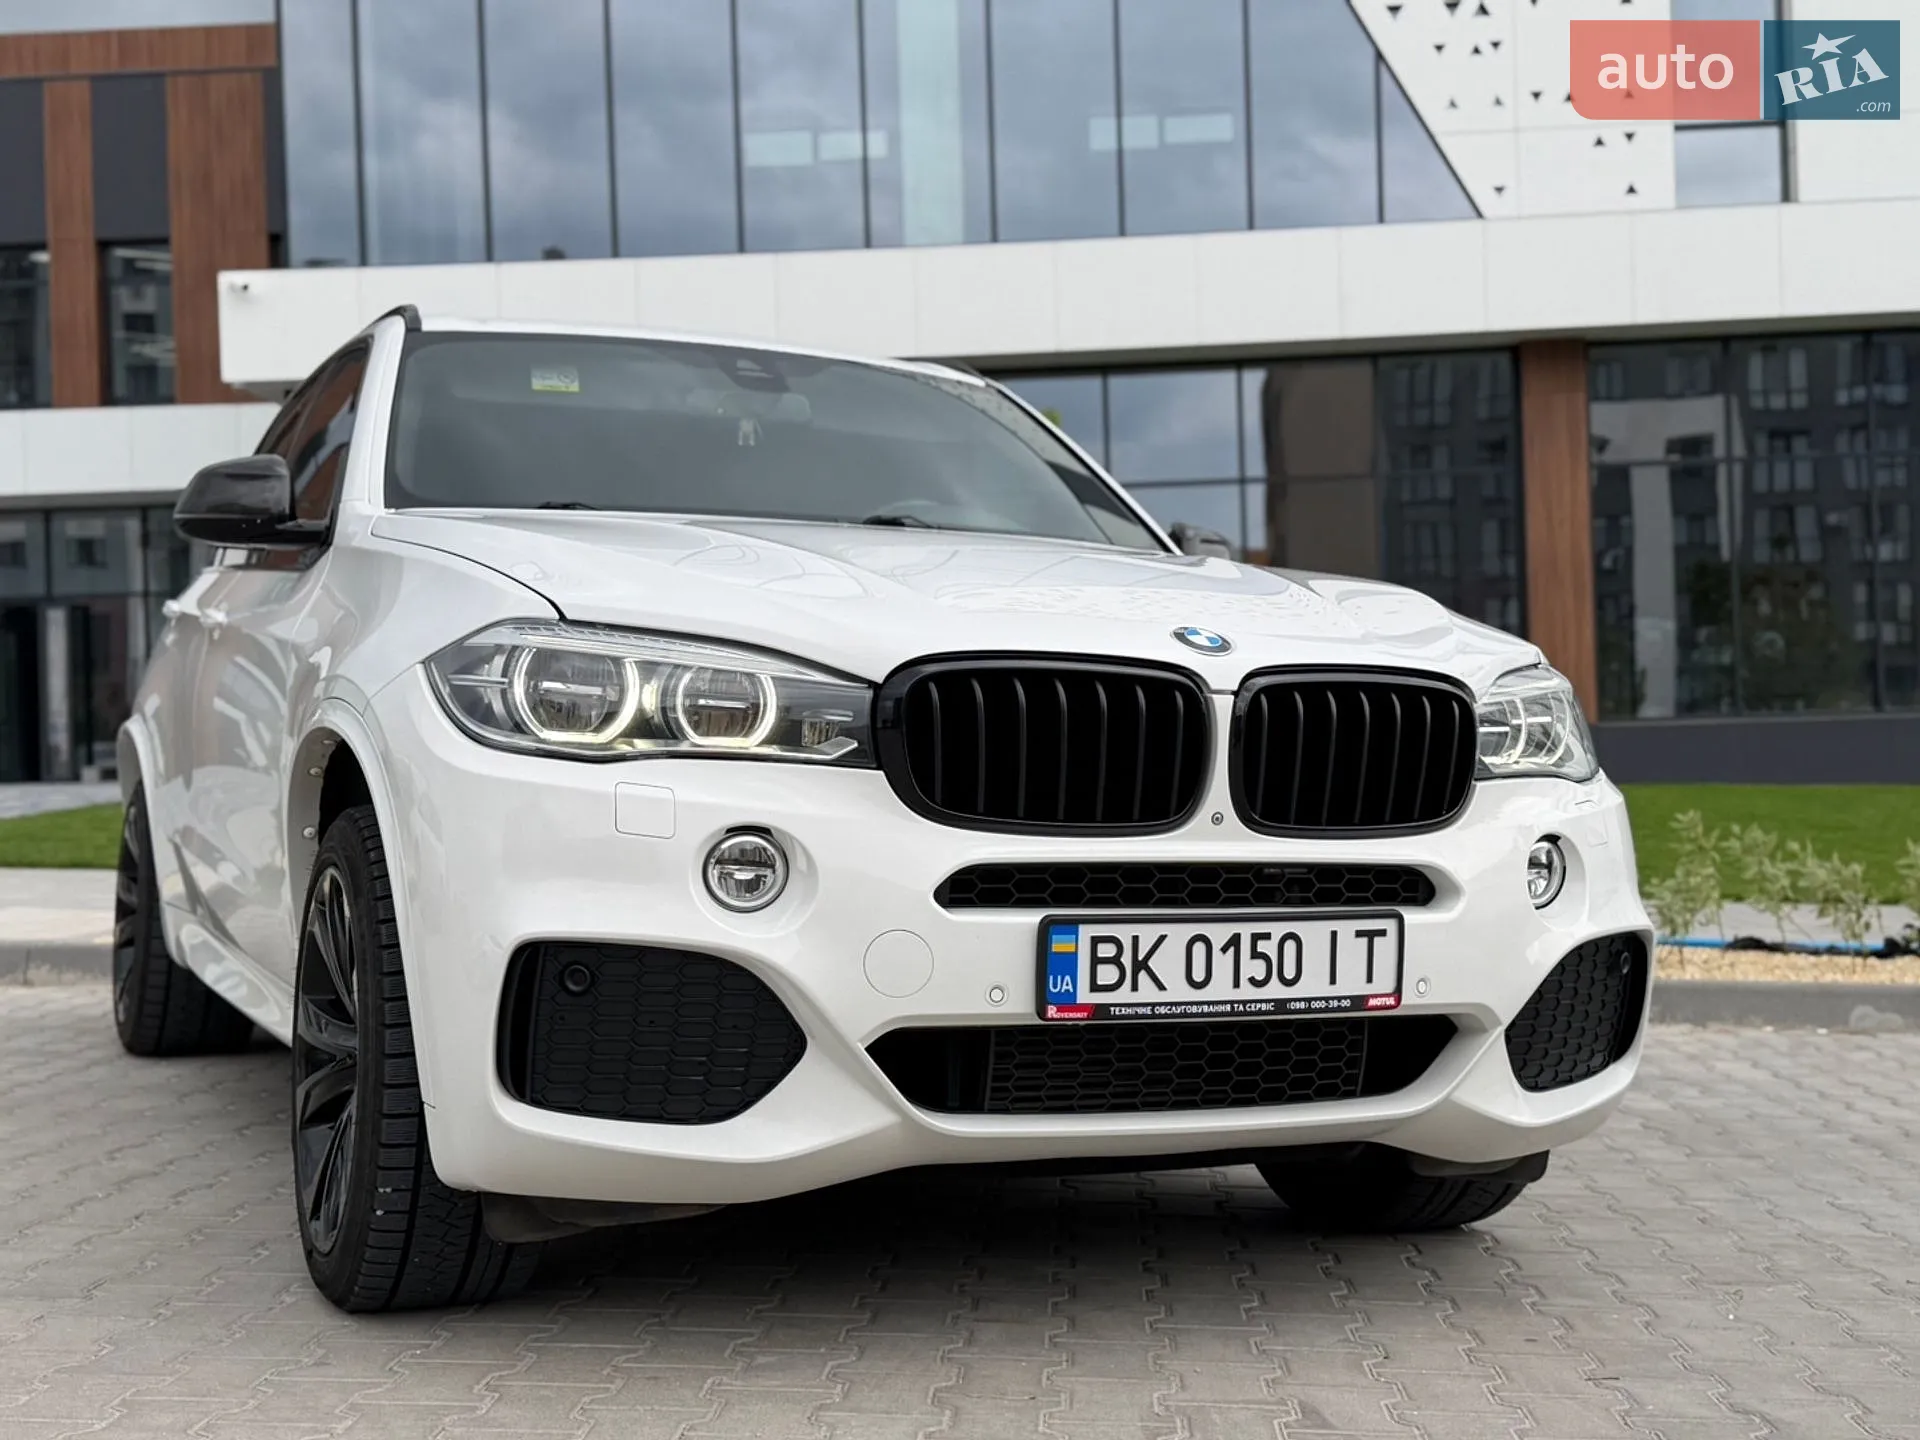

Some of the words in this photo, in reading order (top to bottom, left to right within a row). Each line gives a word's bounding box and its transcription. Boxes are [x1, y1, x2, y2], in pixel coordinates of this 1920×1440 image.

[1089, 933, 1168, 993] BK
[1185, 931, 1303, 990] 0150
[1049, 974, 1074, 993] UA
[1233, 1003, 1244, 1012] ТА
[1245, 1002, 1275, 1011] СЕРВІС
